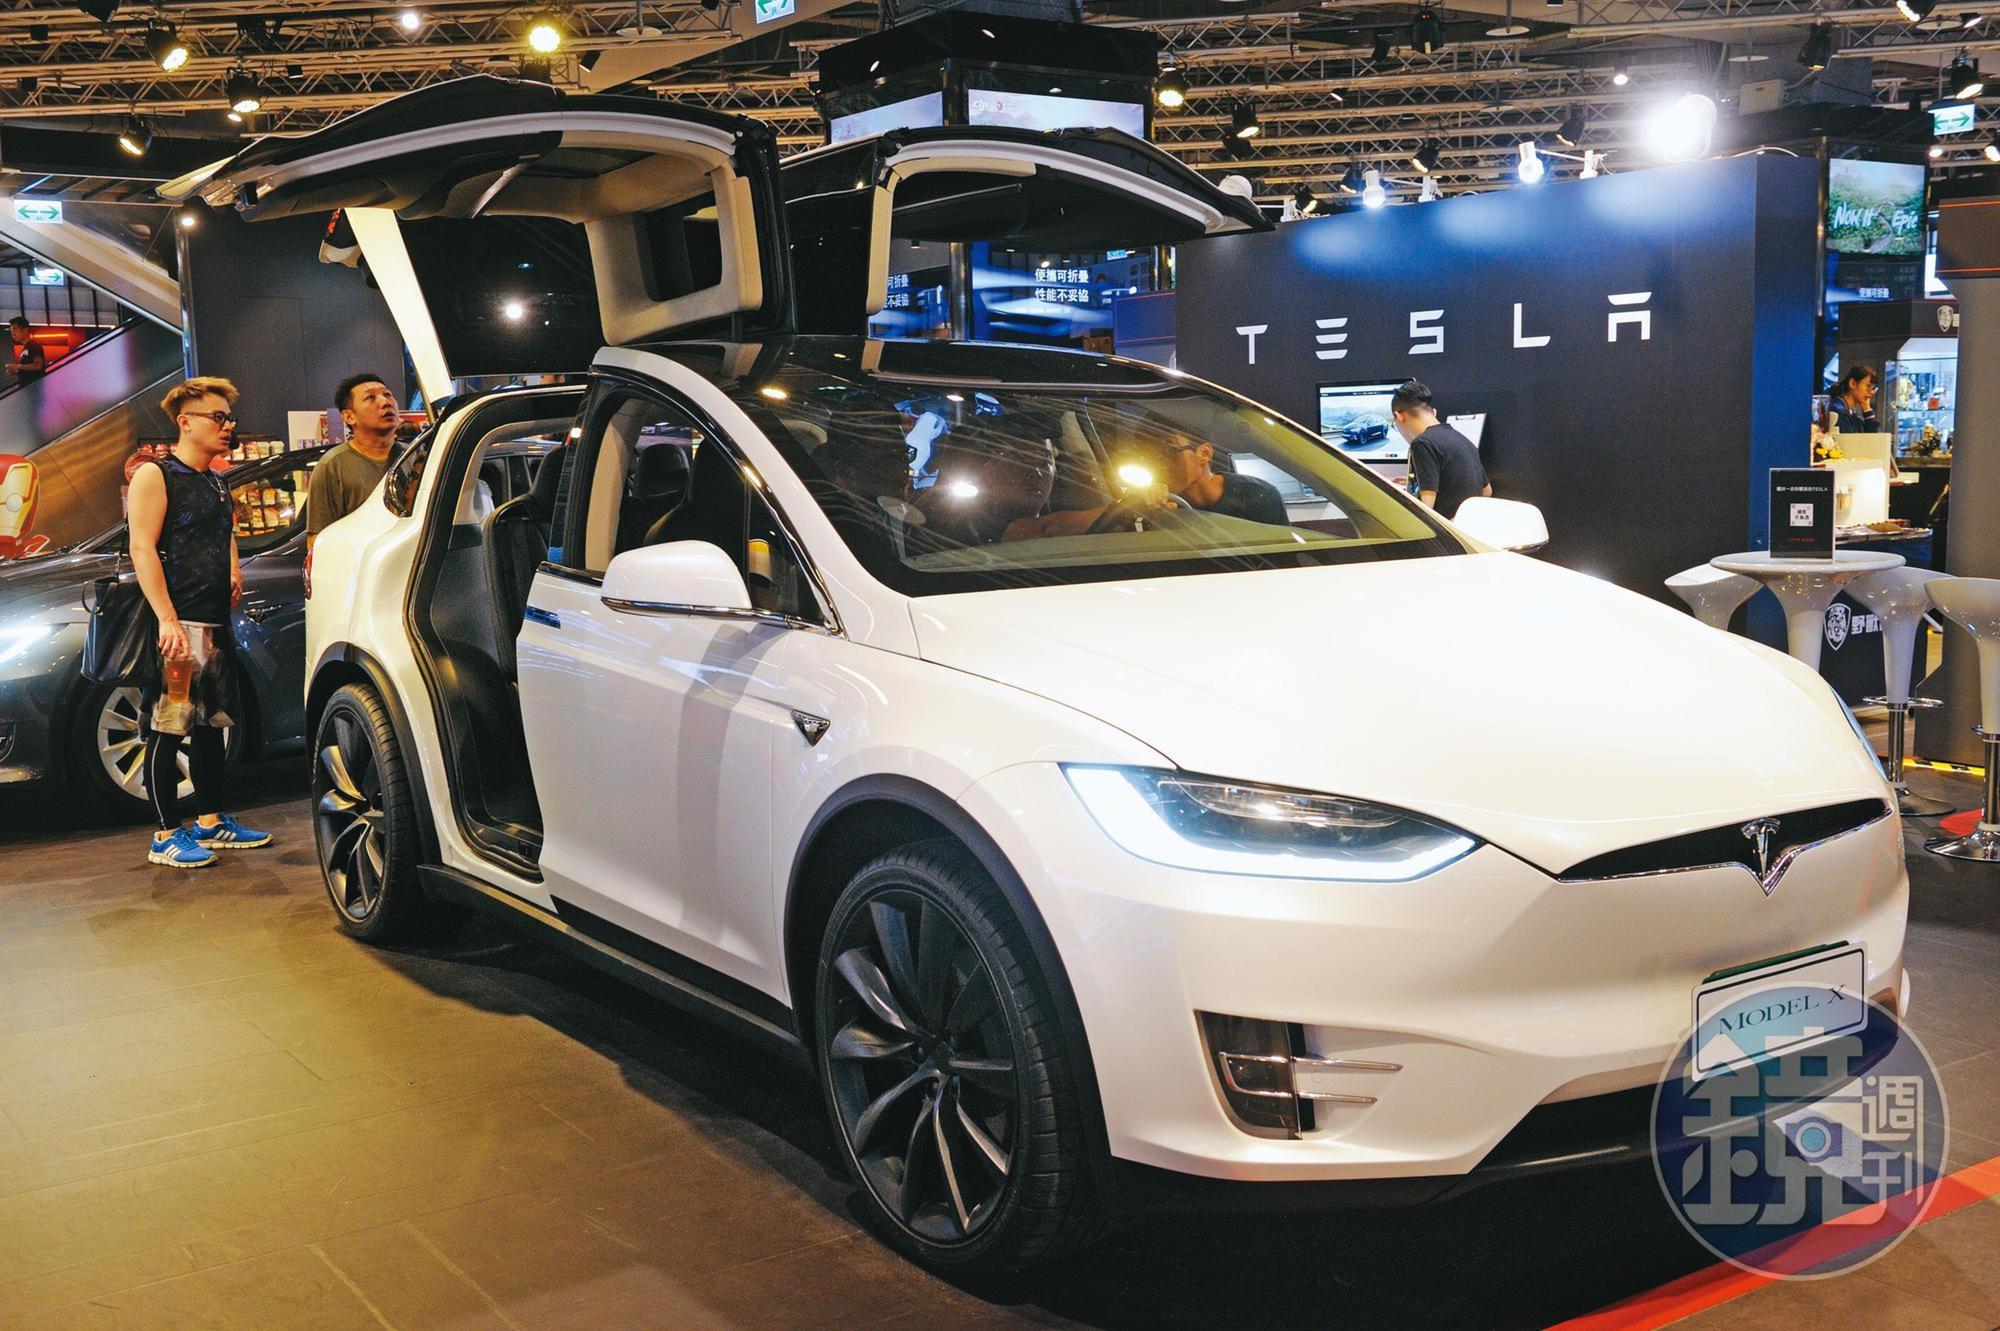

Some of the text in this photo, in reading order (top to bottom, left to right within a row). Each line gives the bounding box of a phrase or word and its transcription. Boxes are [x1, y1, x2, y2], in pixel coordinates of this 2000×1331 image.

[1892, 209, 1919, 235] Epic
[1034, 268, 1089, 283] 便攜可折疊
[1034, 288, 1089, 302] 性能不妥協
[1236, 291, 1652, 364] TESLA
[1851, 614, 1883, 635] 野獸
[1719, 984, 1845, 1035] MODEL X
